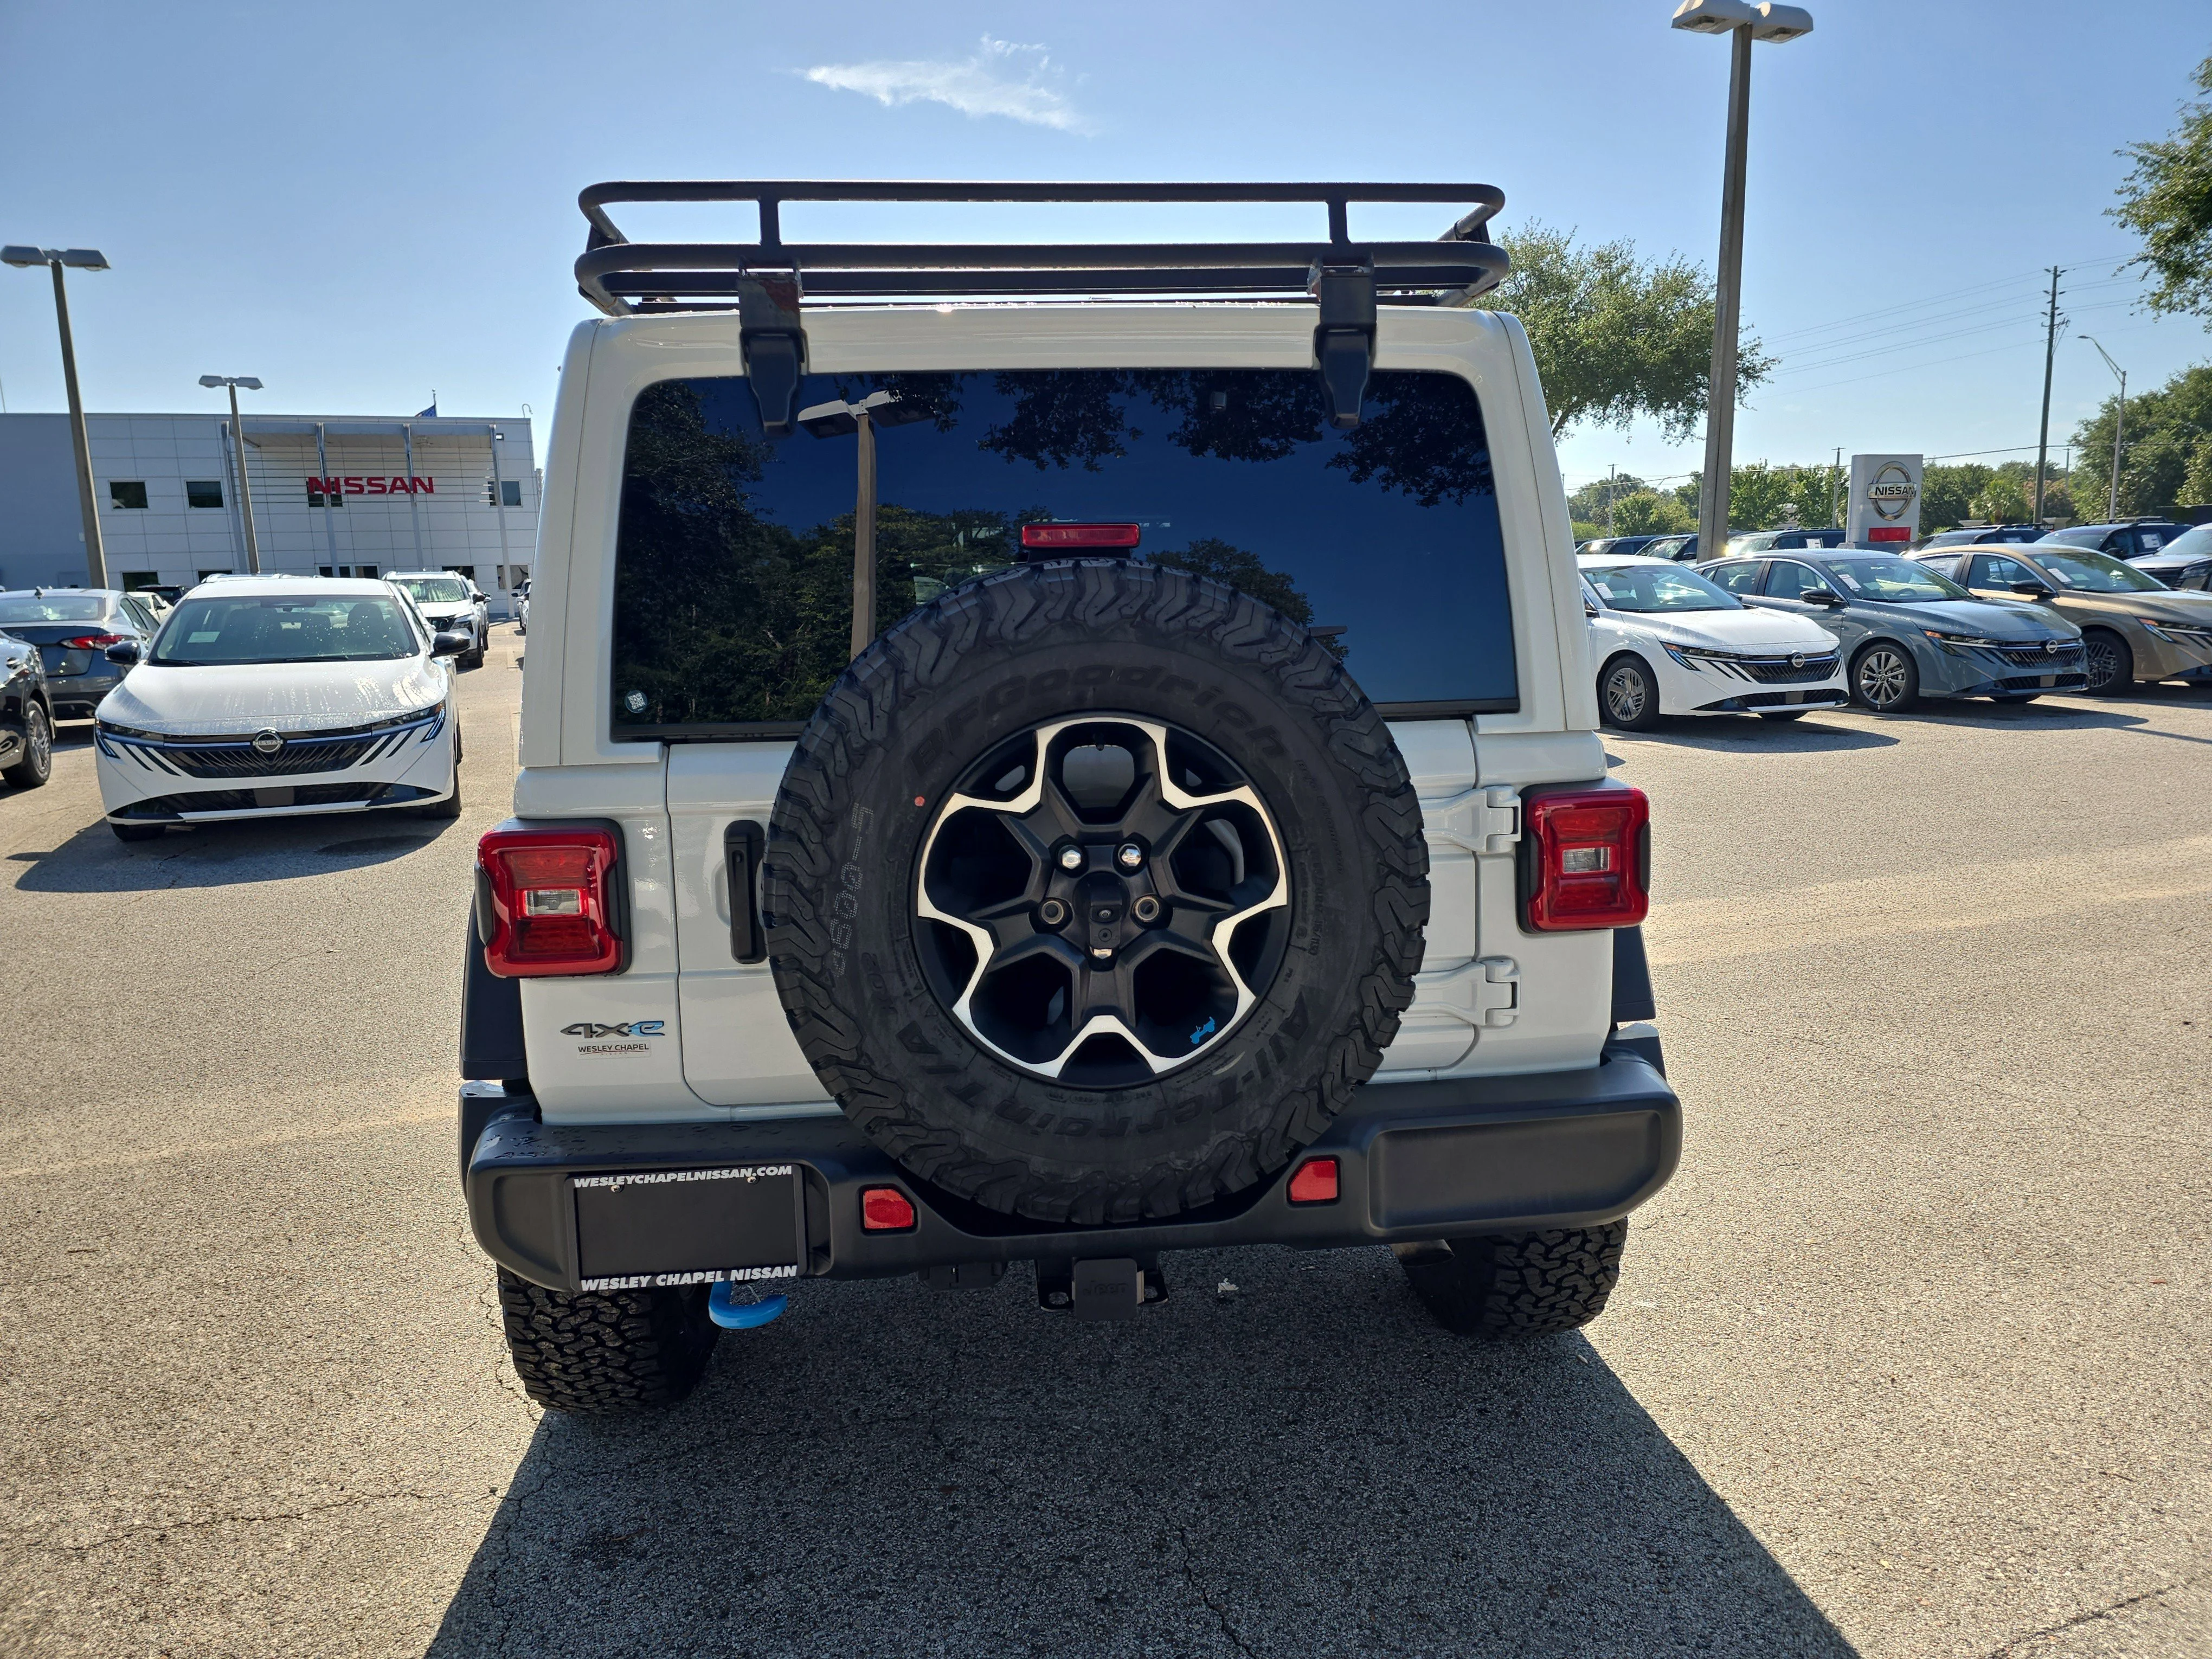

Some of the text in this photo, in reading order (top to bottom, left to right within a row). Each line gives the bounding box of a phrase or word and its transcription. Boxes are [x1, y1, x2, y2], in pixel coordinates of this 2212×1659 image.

[308, 477, 434, 494] NISSAN
[1875, 486, 1914, 496] NISSAN
[909, 664, 1289, 776] BFGoodrich
[896, 993, 1309, 1139] All-Terrain T/A
[574, 1165, 792, 1188] WESLEYCHAPELNISSAN.COM
[581, 1265, 798, 1292] WESLEY CHAPEL NISSAN
